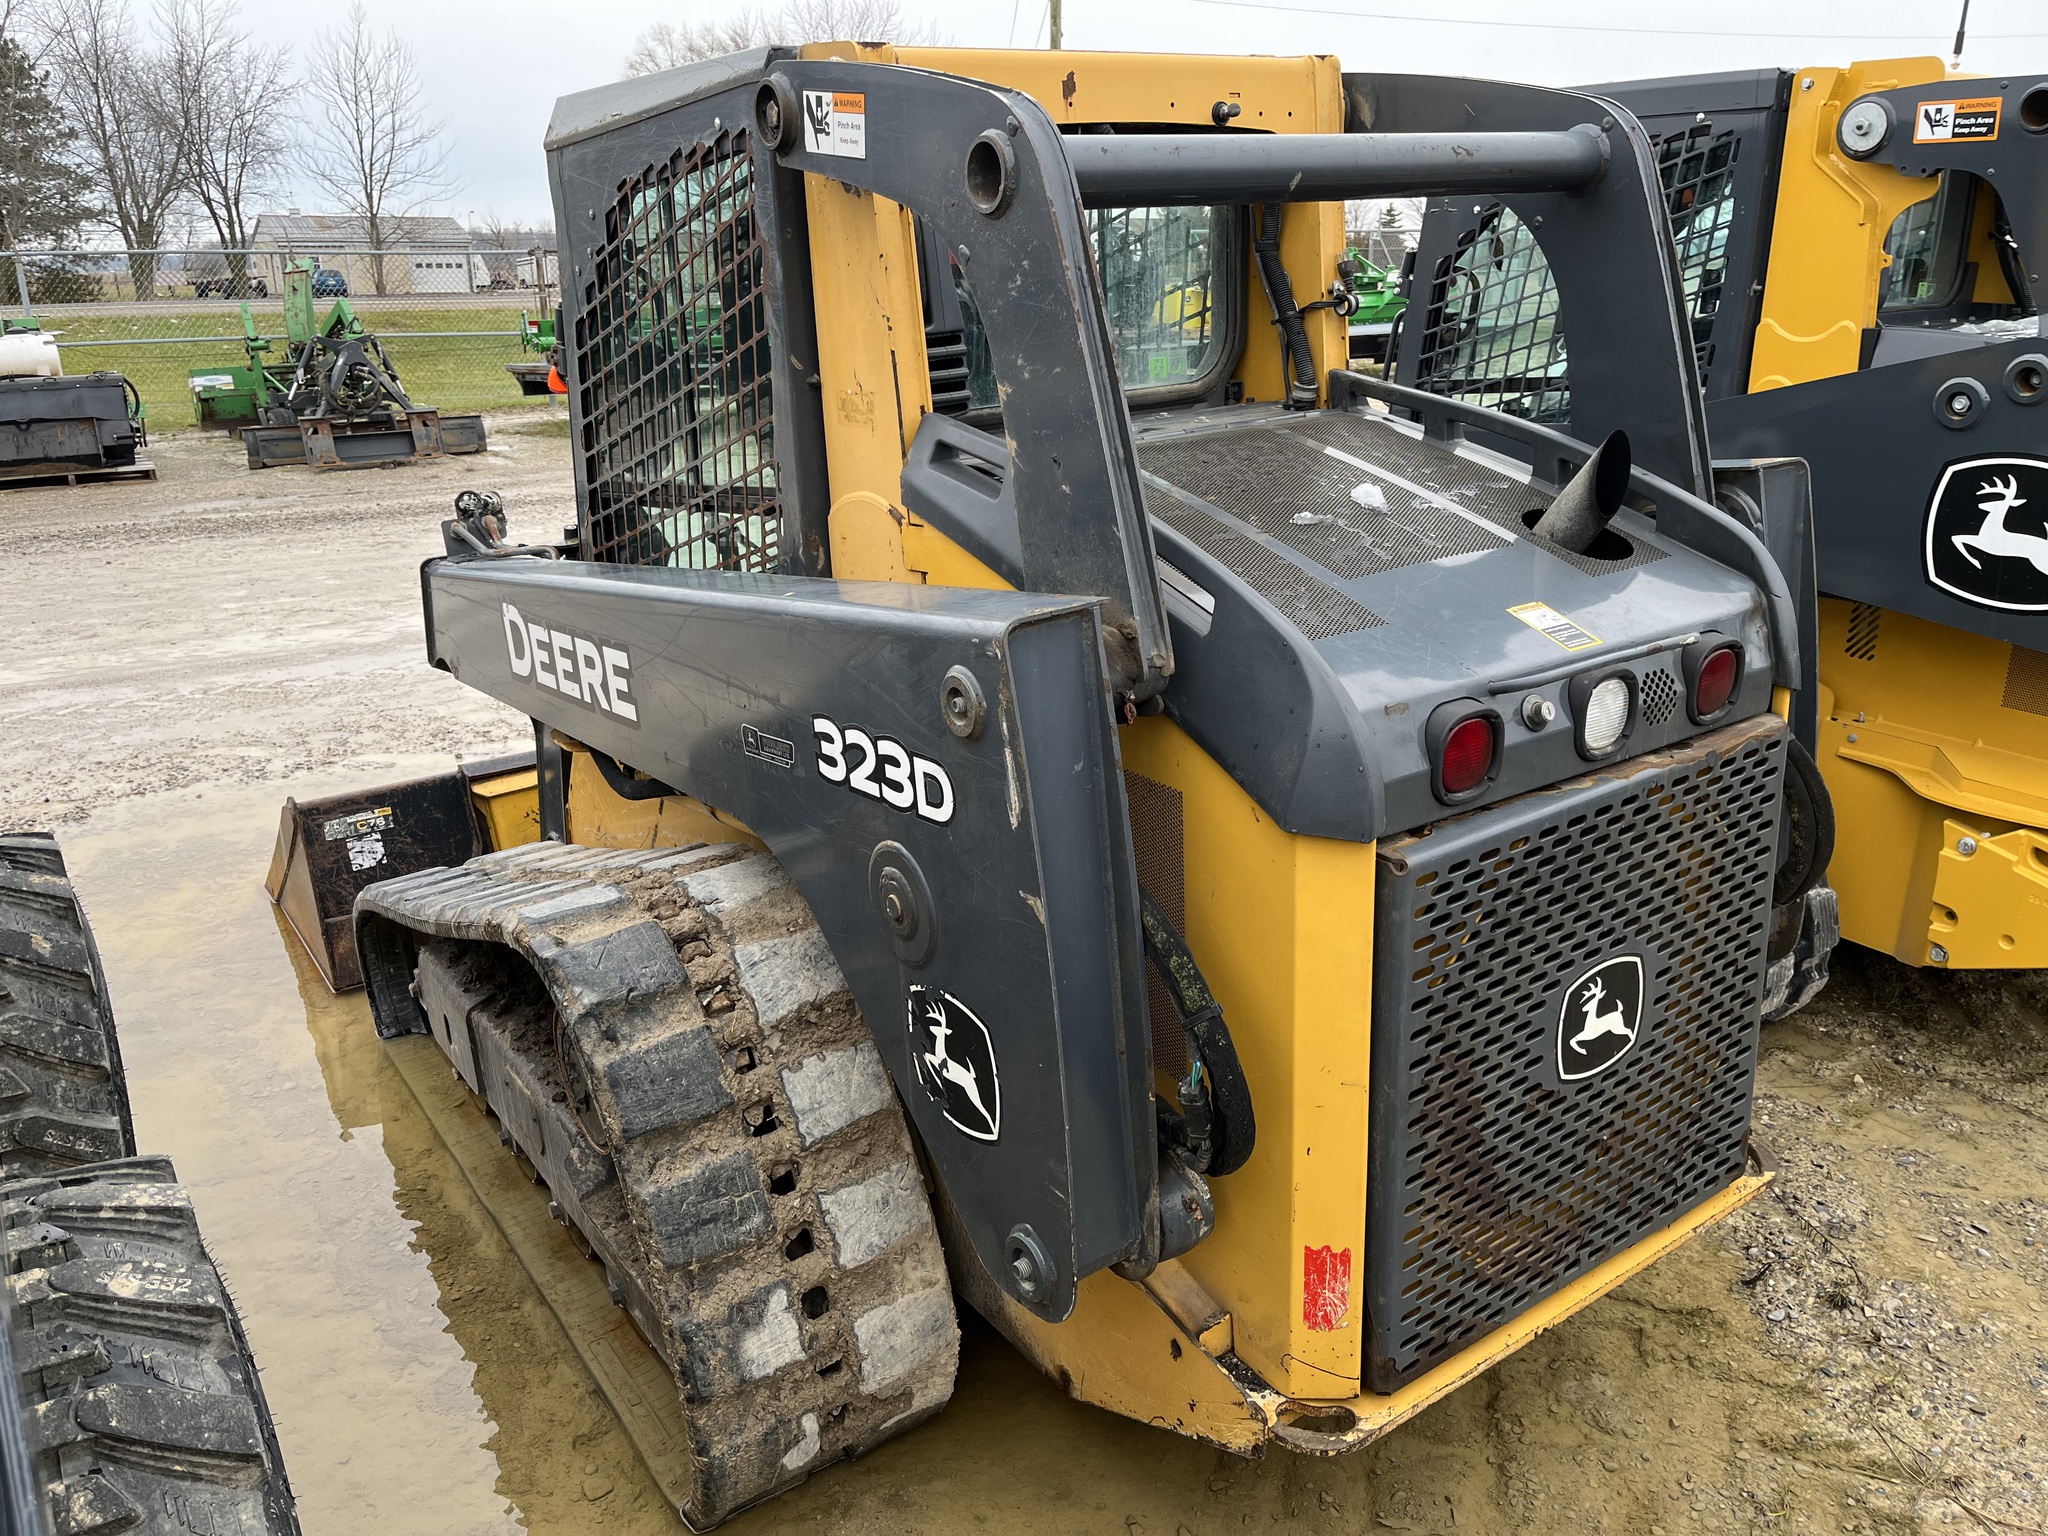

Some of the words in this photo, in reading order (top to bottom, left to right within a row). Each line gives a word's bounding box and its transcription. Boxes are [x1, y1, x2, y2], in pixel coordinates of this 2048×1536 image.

[839, 100, 862, 108] WARNING
[838, 120, 850, 130] Pinch
[851, 122, 861, 130] Area
[1955, 118, 1976, 126] Pinch
[849, 138, 859, 147] Away
[502, 602, 638, 722] DEERE
[814, 717, 955, 824] 323D
[357, 816, 386, 830] C76
[145, 1275, 192, 1293] 532
